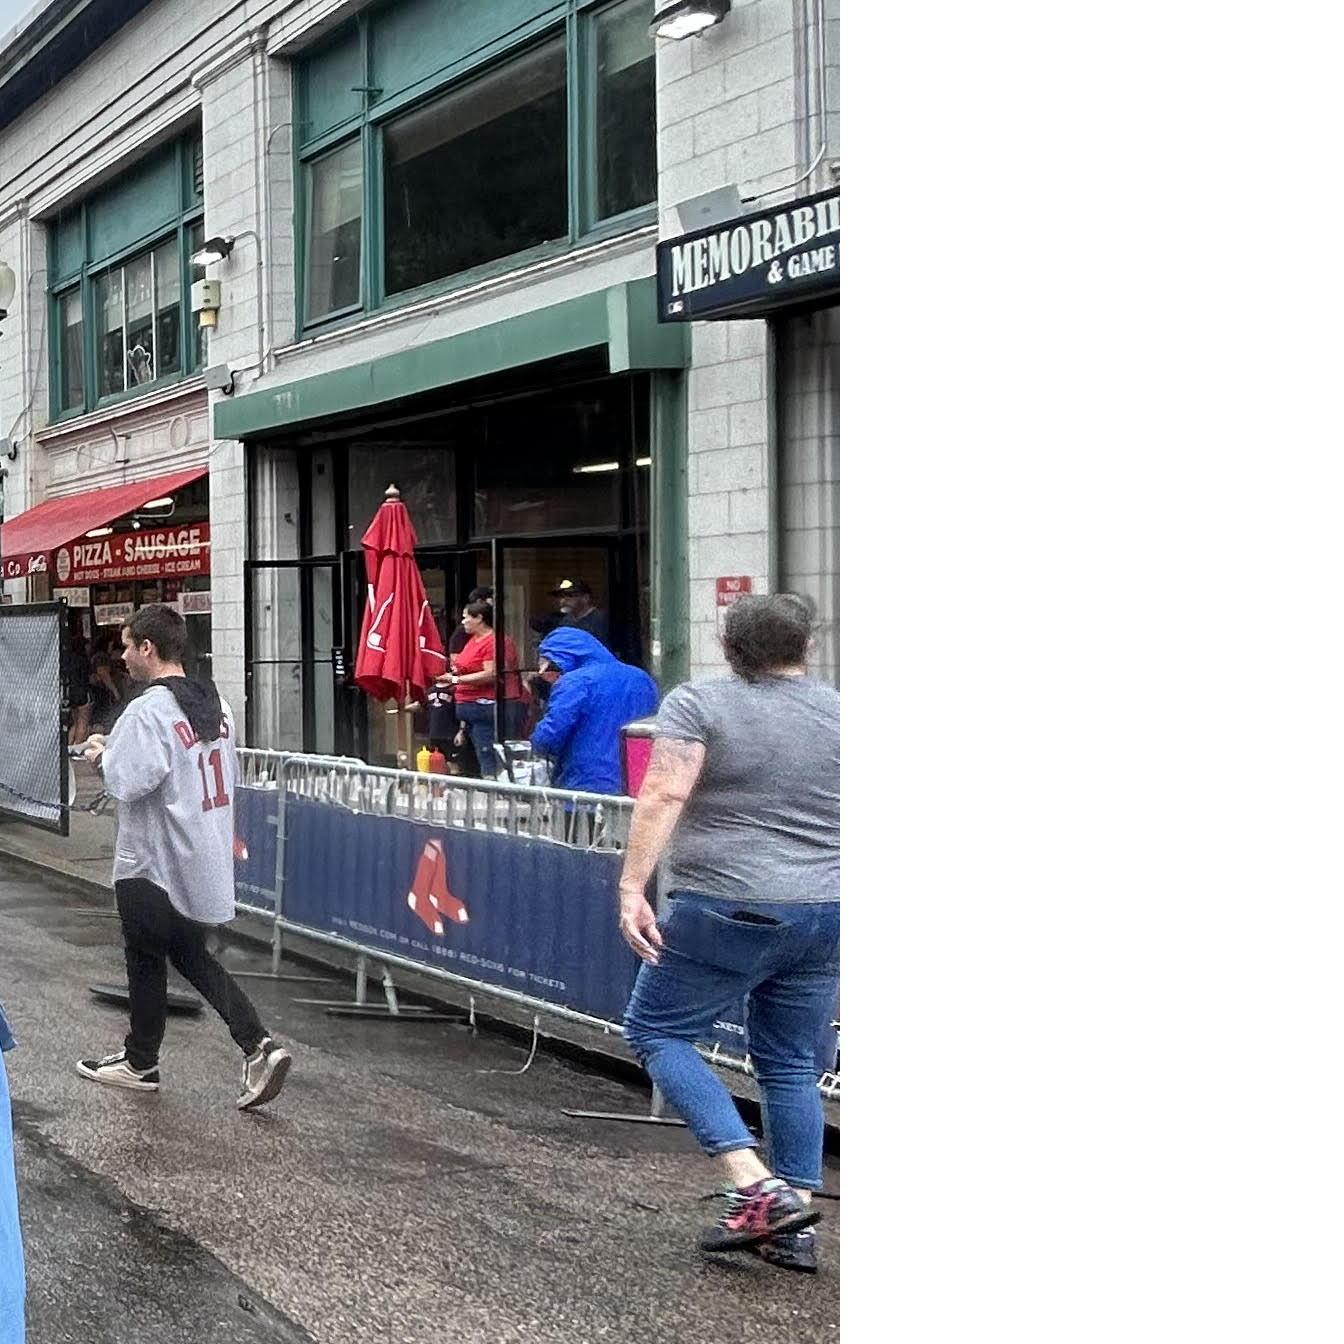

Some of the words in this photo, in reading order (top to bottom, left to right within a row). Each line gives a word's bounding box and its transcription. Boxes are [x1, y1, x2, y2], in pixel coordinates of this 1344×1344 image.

[767, 260, 784, 284] &
[787, 244, 836, 279] GAME
[73, 541, 113, 568] PIZZA
[124, 528, 201, 562] SAUSAGE
[164, 561, 175, 573] ICE
[176, 559, 201, 572] CREAM
[198, 748, 230, 812] 11
[411, 939, 430, 951] CALL
[507, 966, 527, 977] FOR
[528, 972, 566, 991] TICKETS
